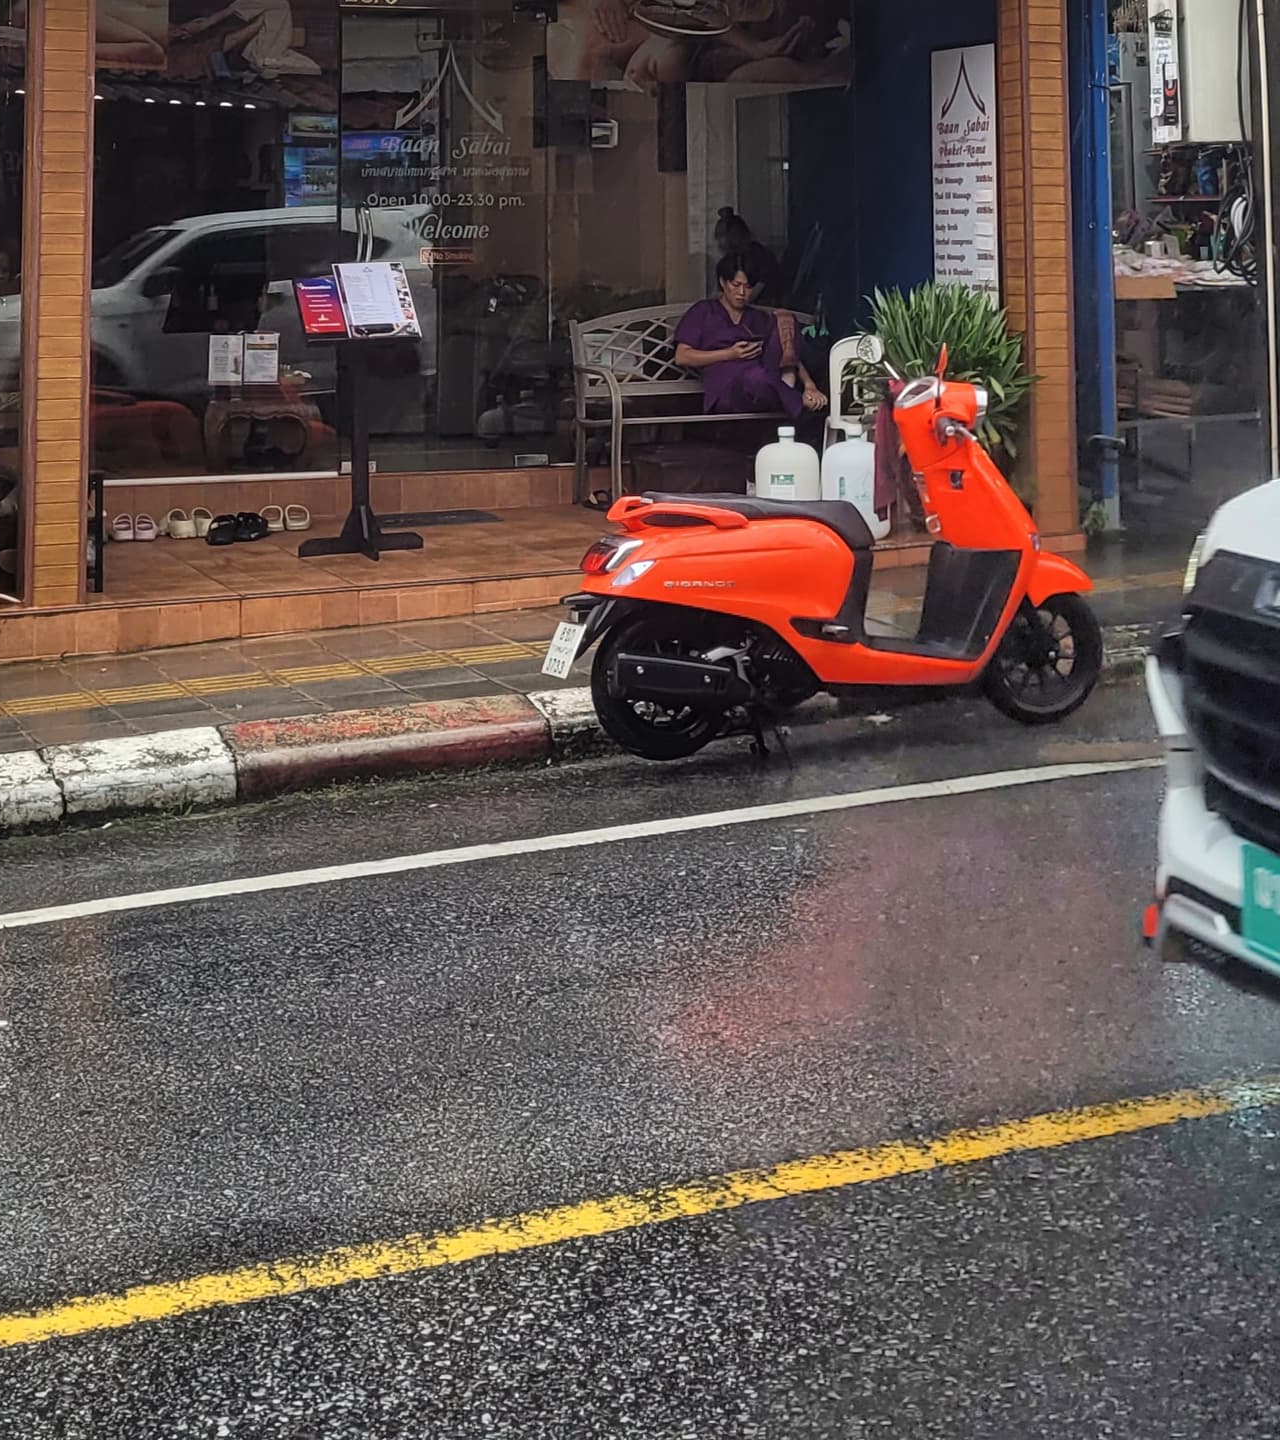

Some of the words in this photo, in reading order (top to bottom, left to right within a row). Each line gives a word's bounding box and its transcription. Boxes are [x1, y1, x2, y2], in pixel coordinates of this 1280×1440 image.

[936, 122, 960, 135] Baan
[964, 116, 990, 137] Sabai
[381, 136, 440, 154] Baan
[452, 135, 512, 160] Sabai
[367, 194, 407, 208] Open
[402, 214, 490, 240] Welcome
